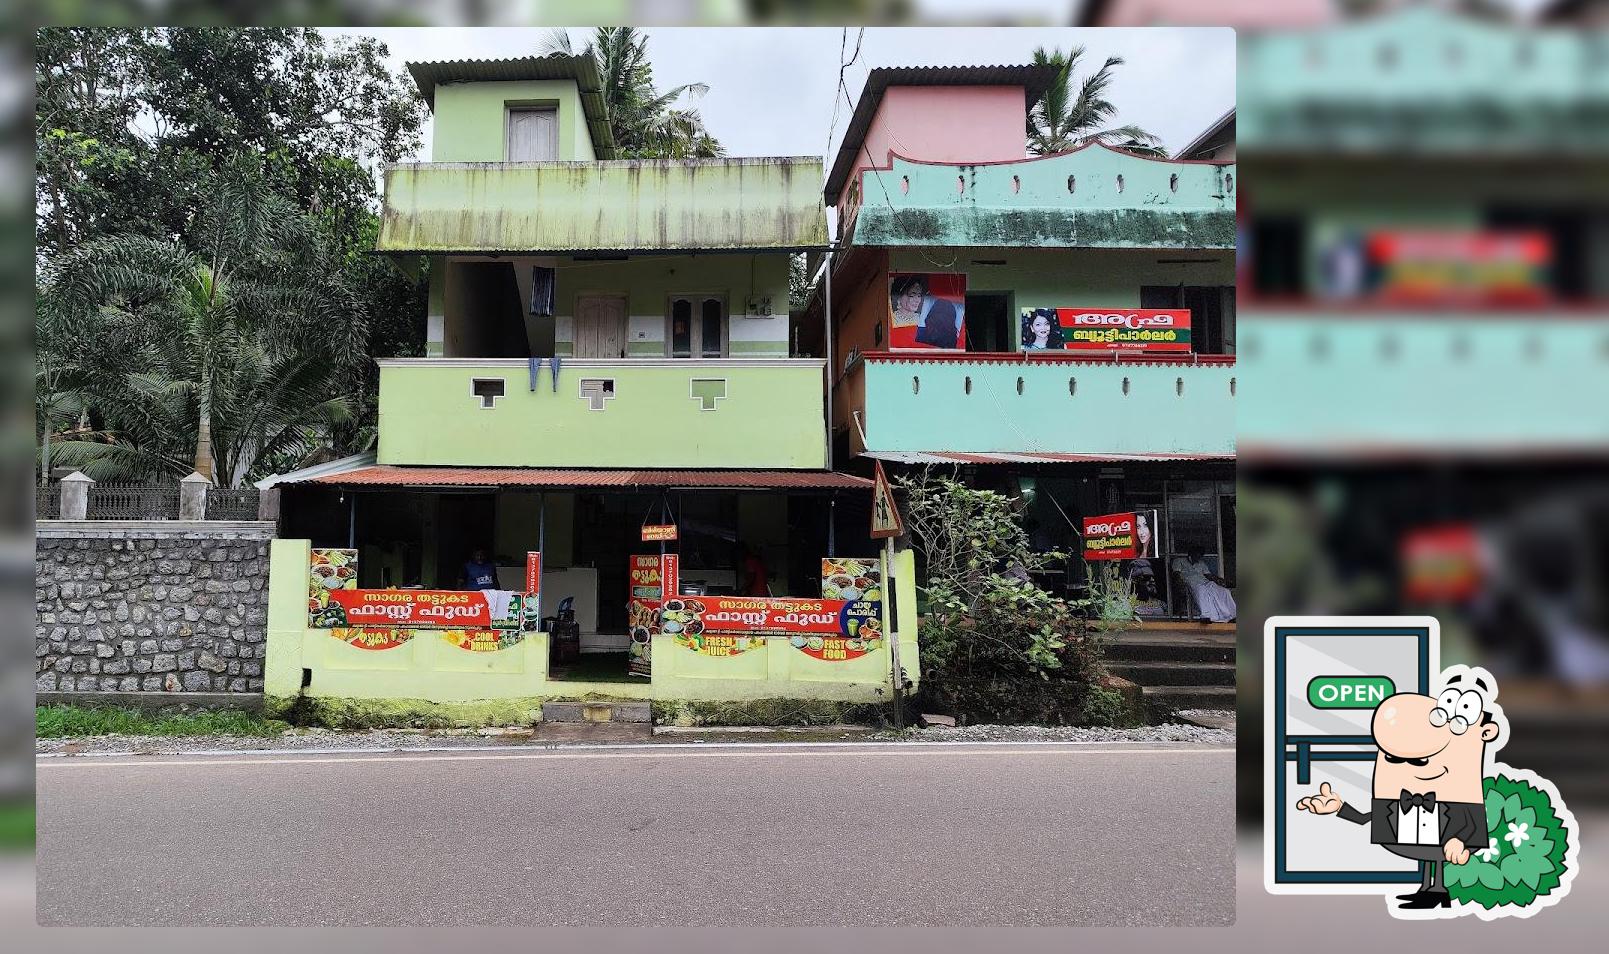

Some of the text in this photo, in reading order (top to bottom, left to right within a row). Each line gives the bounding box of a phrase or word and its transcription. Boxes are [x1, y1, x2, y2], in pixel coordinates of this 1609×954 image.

[364, 593, 469, 605] സാഗര തട്ടുകട
[419, 603, 485, 620] ഫുഡ്
[719, 601, 823, 613] സാഗര തട്ടുകട
[773, 612, 838, 626] ഫുഡ്
[474, 632, 494, 641] COOL
[705, 636, 734, 646] FRESH
[470, 641, 499, 652] DRINKS
[823, 639, 846, 649] FAST
[706, 646, 733, 657] JUICE
[822, 649, 847, 660] FOOD
